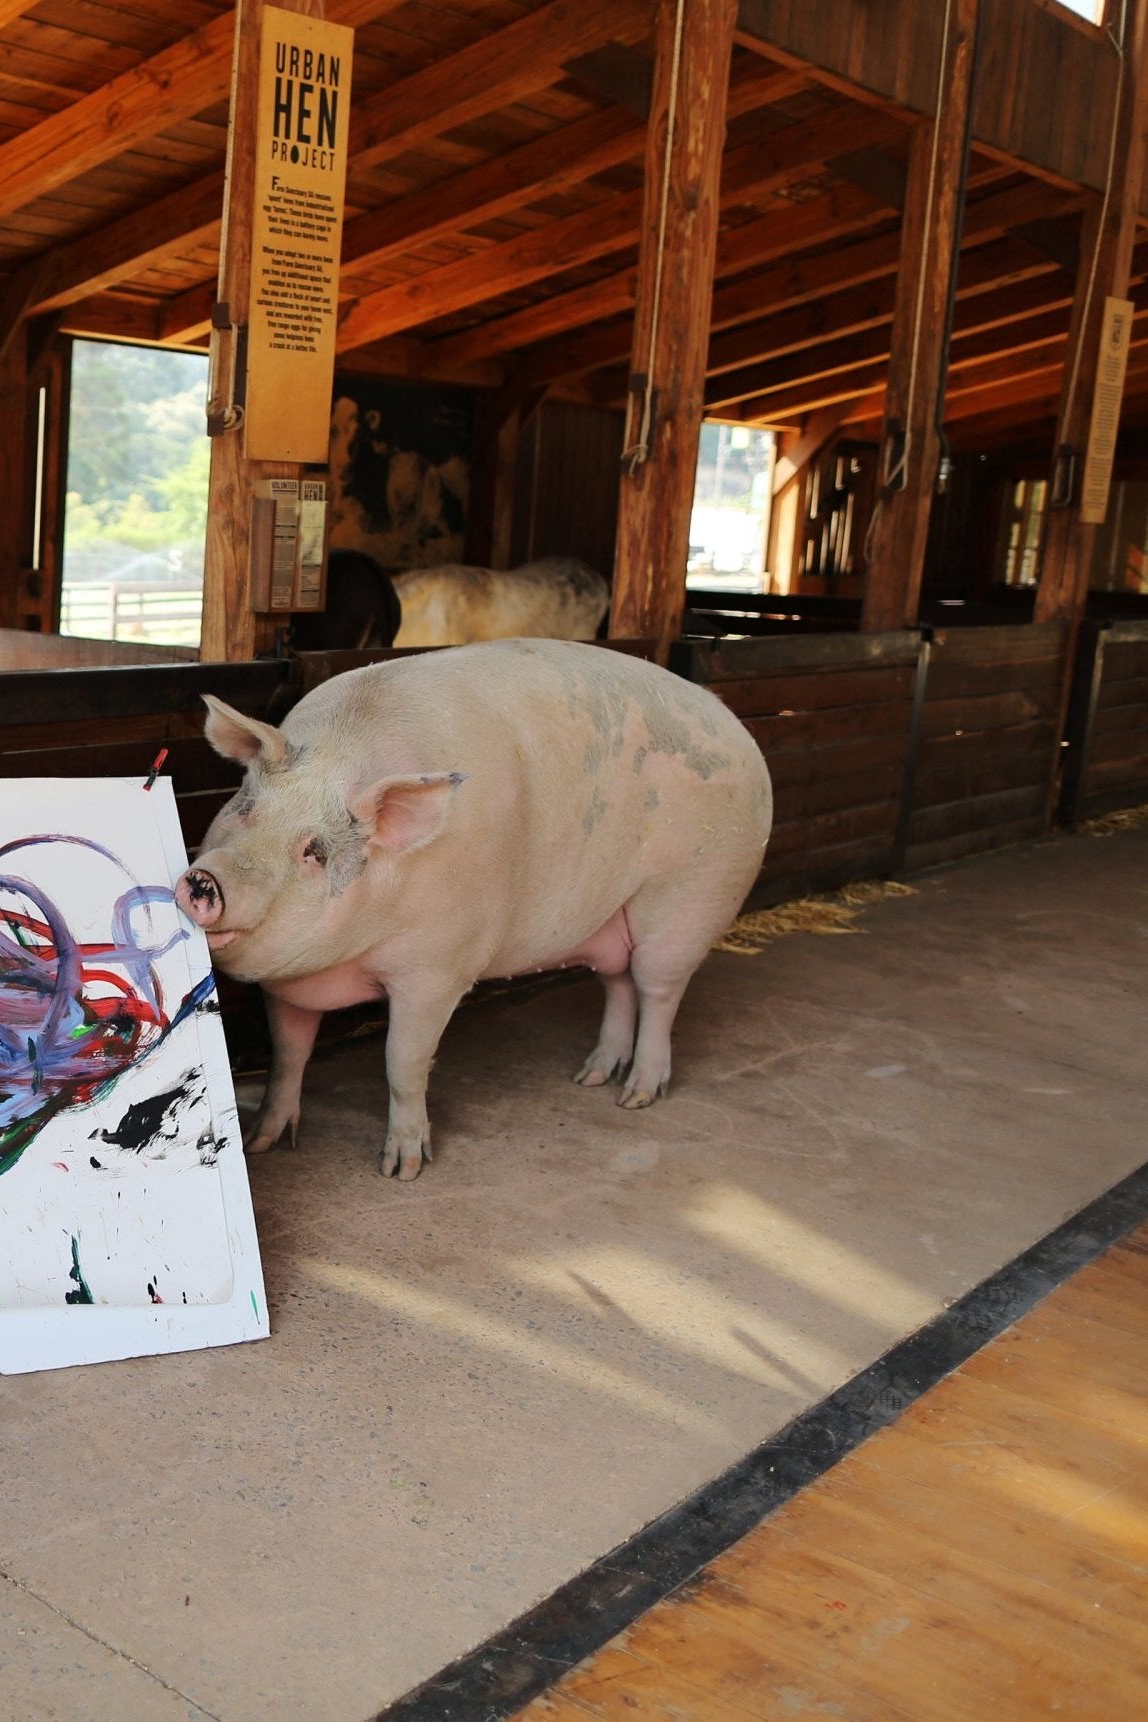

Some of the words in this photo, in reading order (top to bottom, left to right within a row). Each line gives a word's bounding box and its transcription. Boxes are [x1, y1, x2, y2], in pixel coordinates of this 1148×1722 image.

[276, 42, 340, 87] URBAN
[273, 76, 338, 149] HEN
[272, 140, 335, 171] PROJECT
